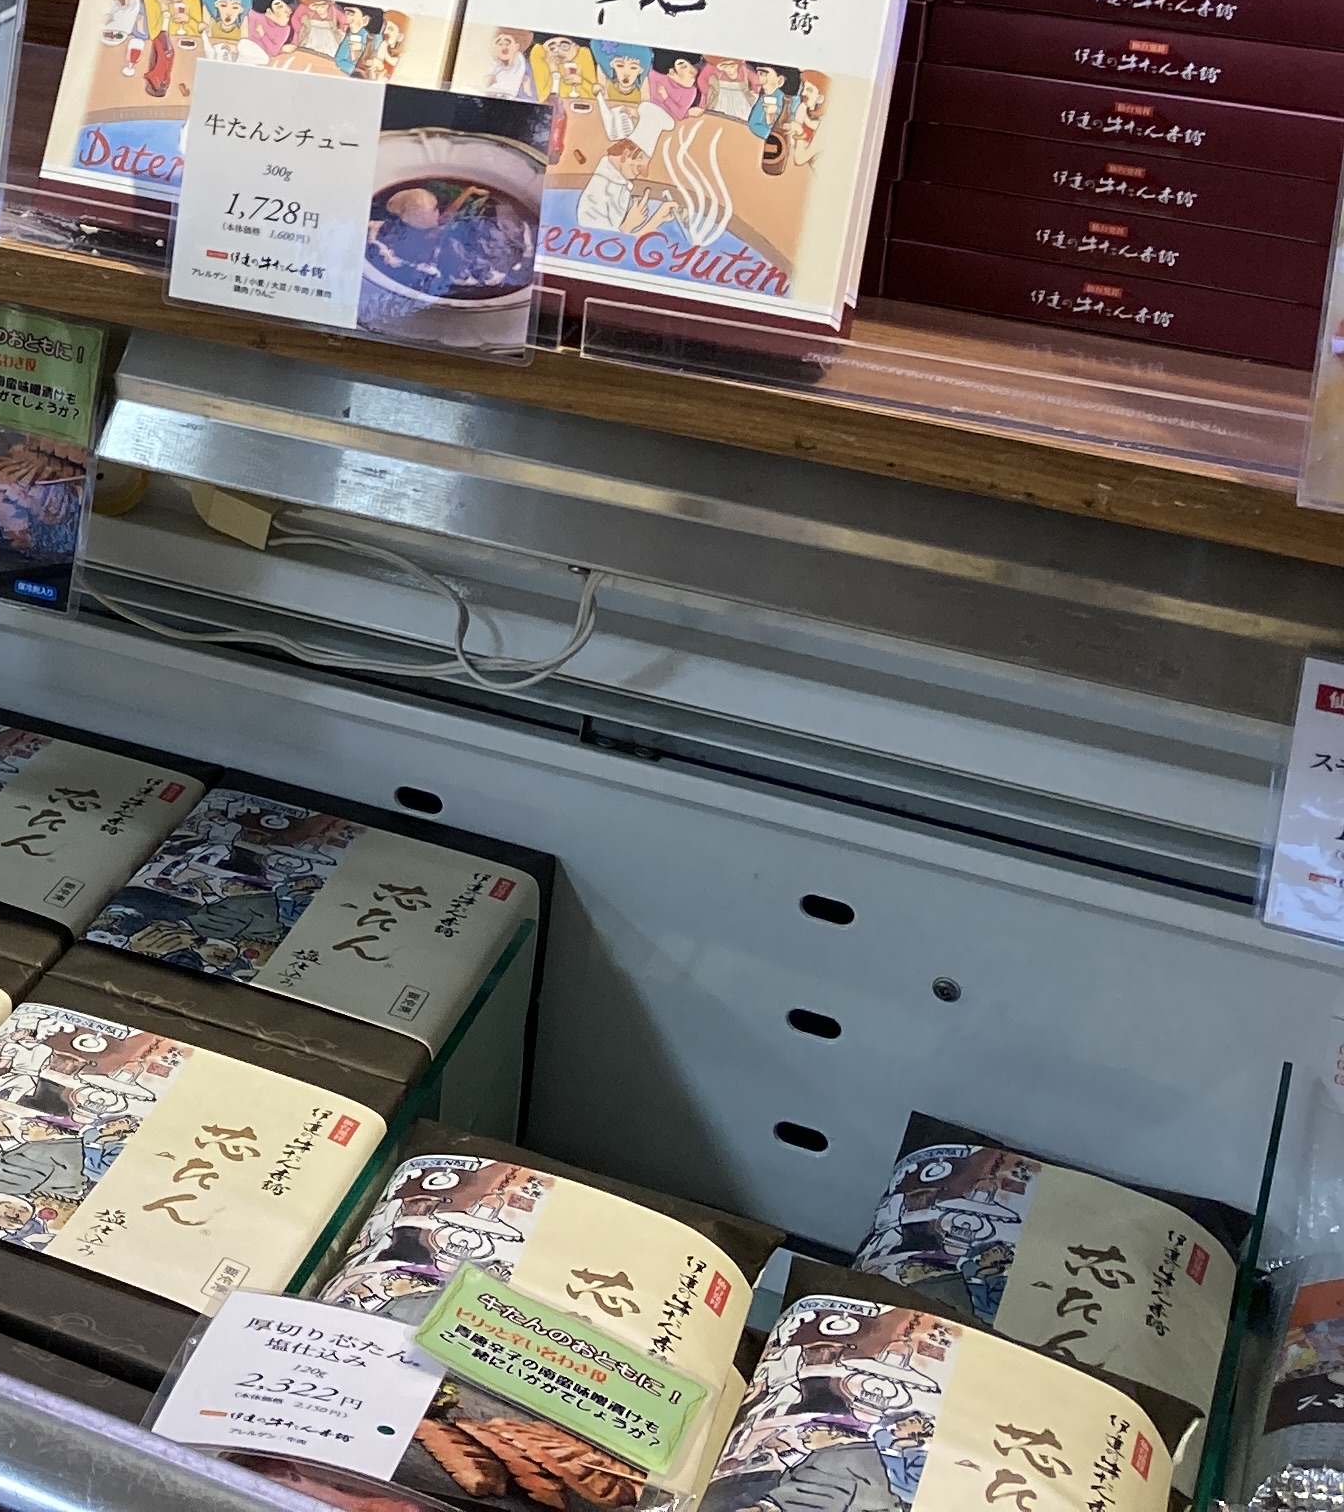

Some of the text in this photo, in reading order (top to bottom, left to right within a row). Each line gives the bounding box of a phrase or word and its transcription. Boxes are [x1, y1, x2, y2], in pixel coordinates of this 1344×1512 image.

[1072, 46, 1222, 84] 伊達の牛たん本舗
[204, 111, 360, 151] 牛たんシチュー
[1059, 108, 1207, 147] 伊達の牛たん本舗
[263, 164, 294, 181] 300g
[1051, 168, 1198, 208] 伊達の牛たん本舗
[223, 191, 320, 230] 1,728円
[269, 229, 311, 244] 1,600円)
[1034, 227, 1180, 267] 伊達の牛たん本舗
[230, 251, 326, 280] 伊達の牛たん本舗
[541, 221, 791, 296] eno Gyutan
[1030, 288, 1174, 329] 伊達の牛たん本舗
[329, 879, 432, 964] 芯たん
[142, 1121, 263, 1229] 芯たん
[75, 1206, 129, 1258] 塩仕込み
[264, 1336, 369, 1369] 塩仕込み
[475, 1290, 681, 1406] 牛たんのおともに！
[291, 1360, 329, 1379] 120g
[233, 1371, 364, 1413] 2,322円
[437, 1330, 662, 1450] ご一緒にいかがでしょうか？
